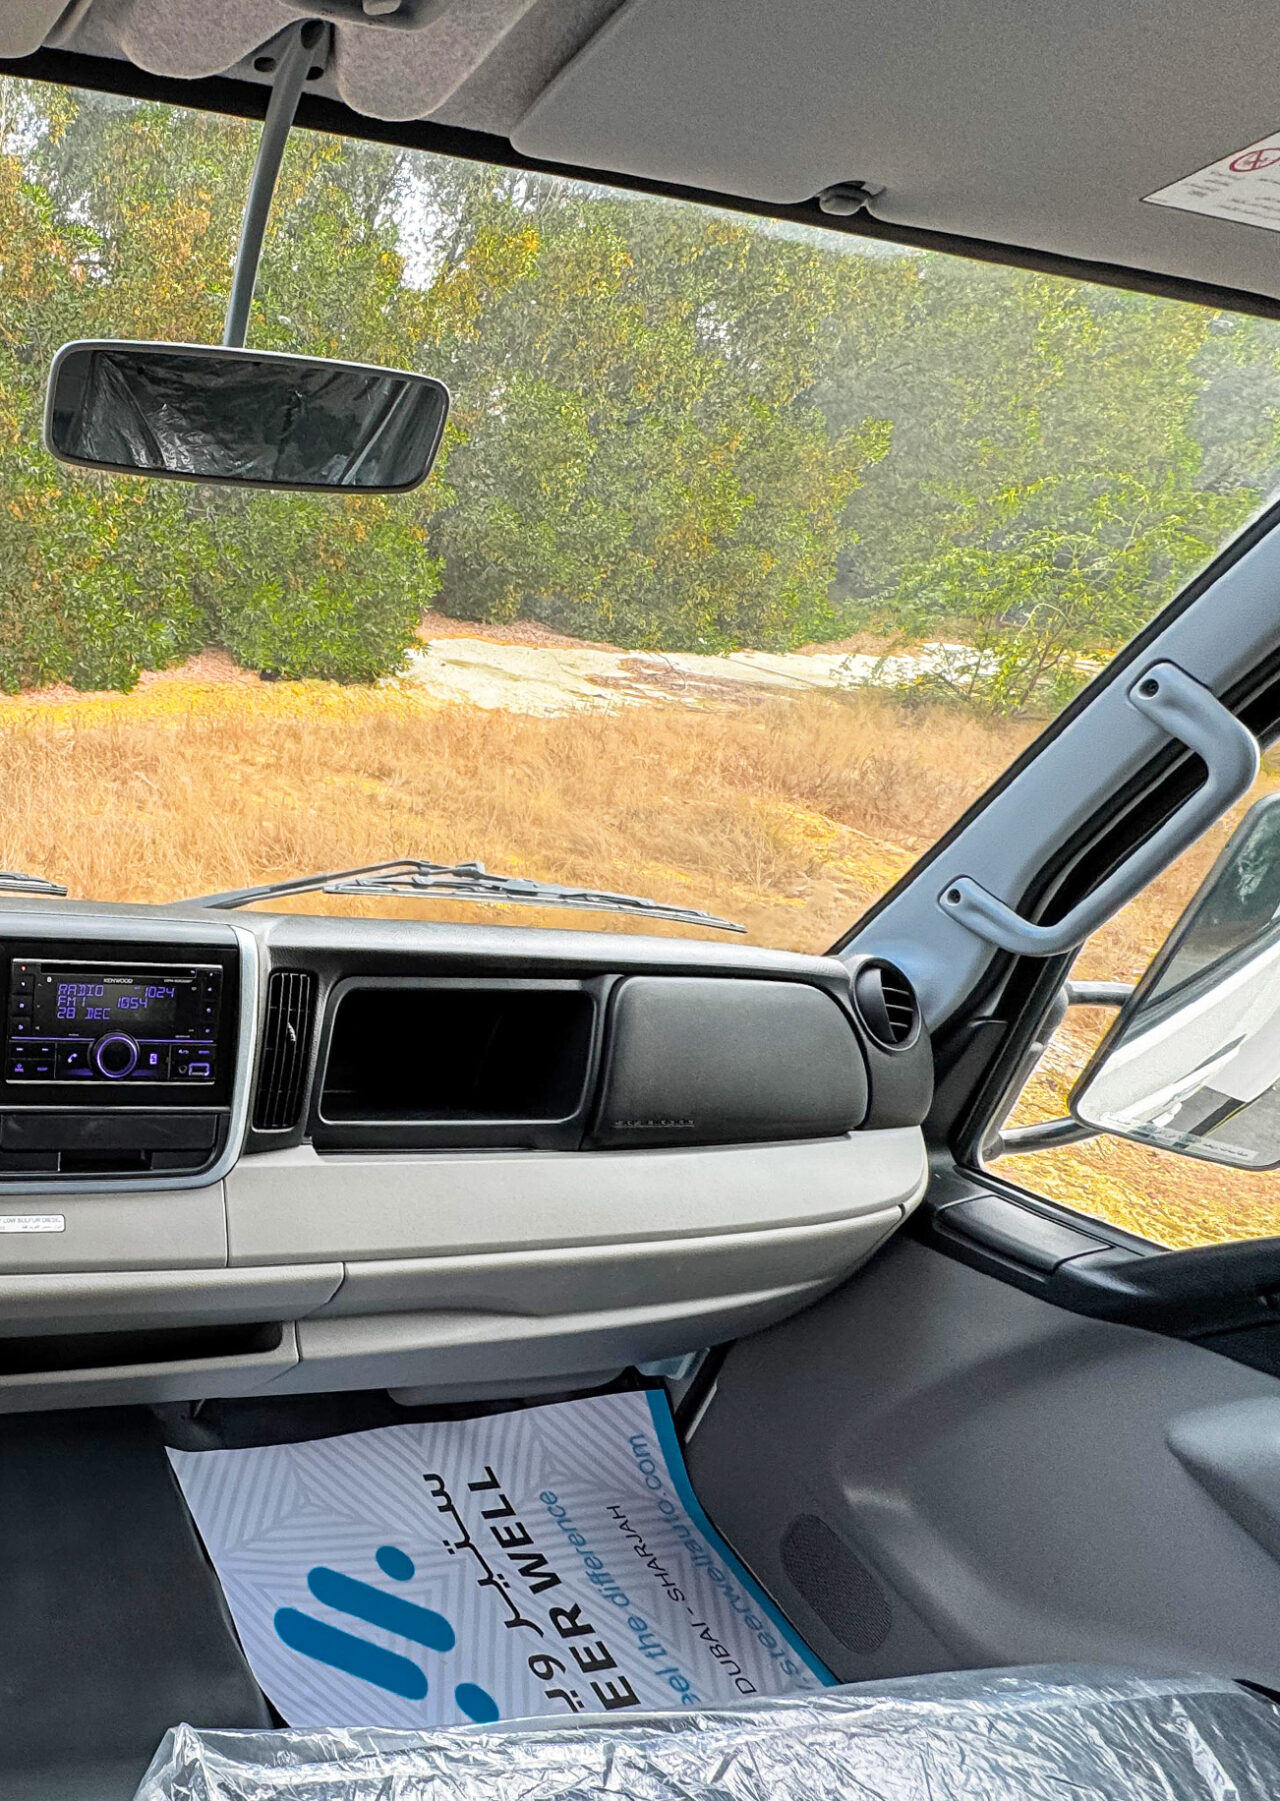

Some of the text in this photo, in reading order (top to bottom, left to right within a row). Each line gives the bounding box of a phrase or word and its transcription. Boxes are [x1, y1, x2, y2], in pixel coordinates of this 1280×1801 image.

[58, 984, 104, 996] RADIO
[85, 1007, 111, 1019] DEC
[539, 1490, 630, 1608] difference
[606, 1505, 685, 1602] SHARJAH
[467, 1466, 641, 1711] EER WELL
[627, 1614, 667, 1660] the
[691, 1622, 757, 1694] DUBAI
[528, 1654, 585, 1712] وي
